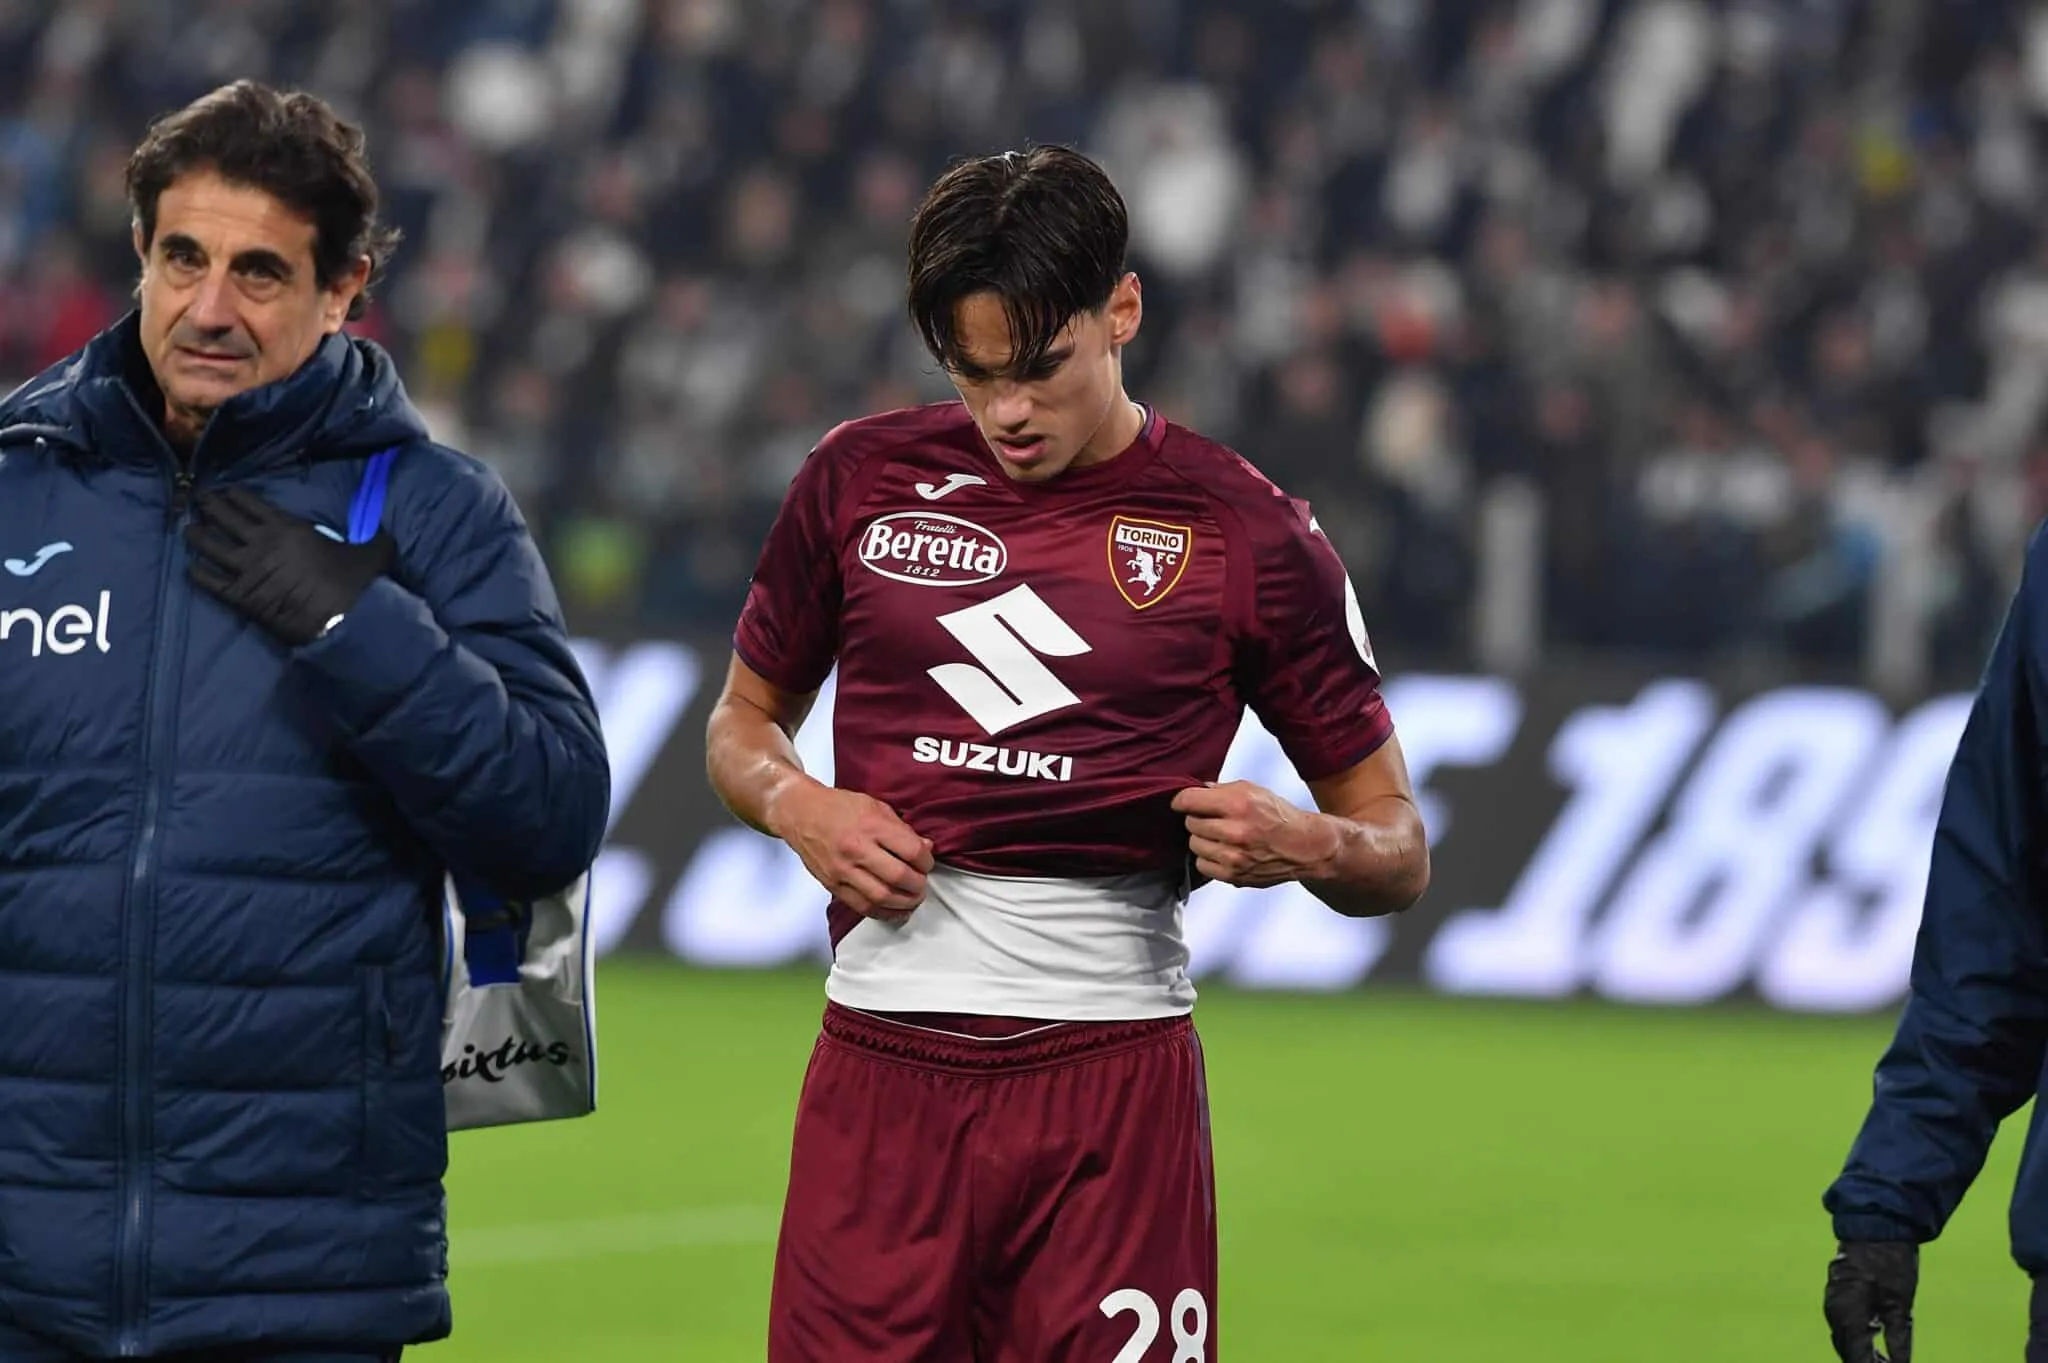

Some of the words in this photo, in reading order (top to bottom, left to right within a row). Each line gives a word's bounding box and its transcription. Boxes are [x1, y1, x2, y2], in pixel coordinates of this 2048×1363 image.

[863, 525, 1000, 574] Beretta
[1121, 528, 1179, 548] TORINO
[904, 565, 940, 577] 1812
[1156, 552, 1176, 565] FC
[912, 736, 1073, 782] SUZUKI
[1098, 1288, 1208, 1363] 28
